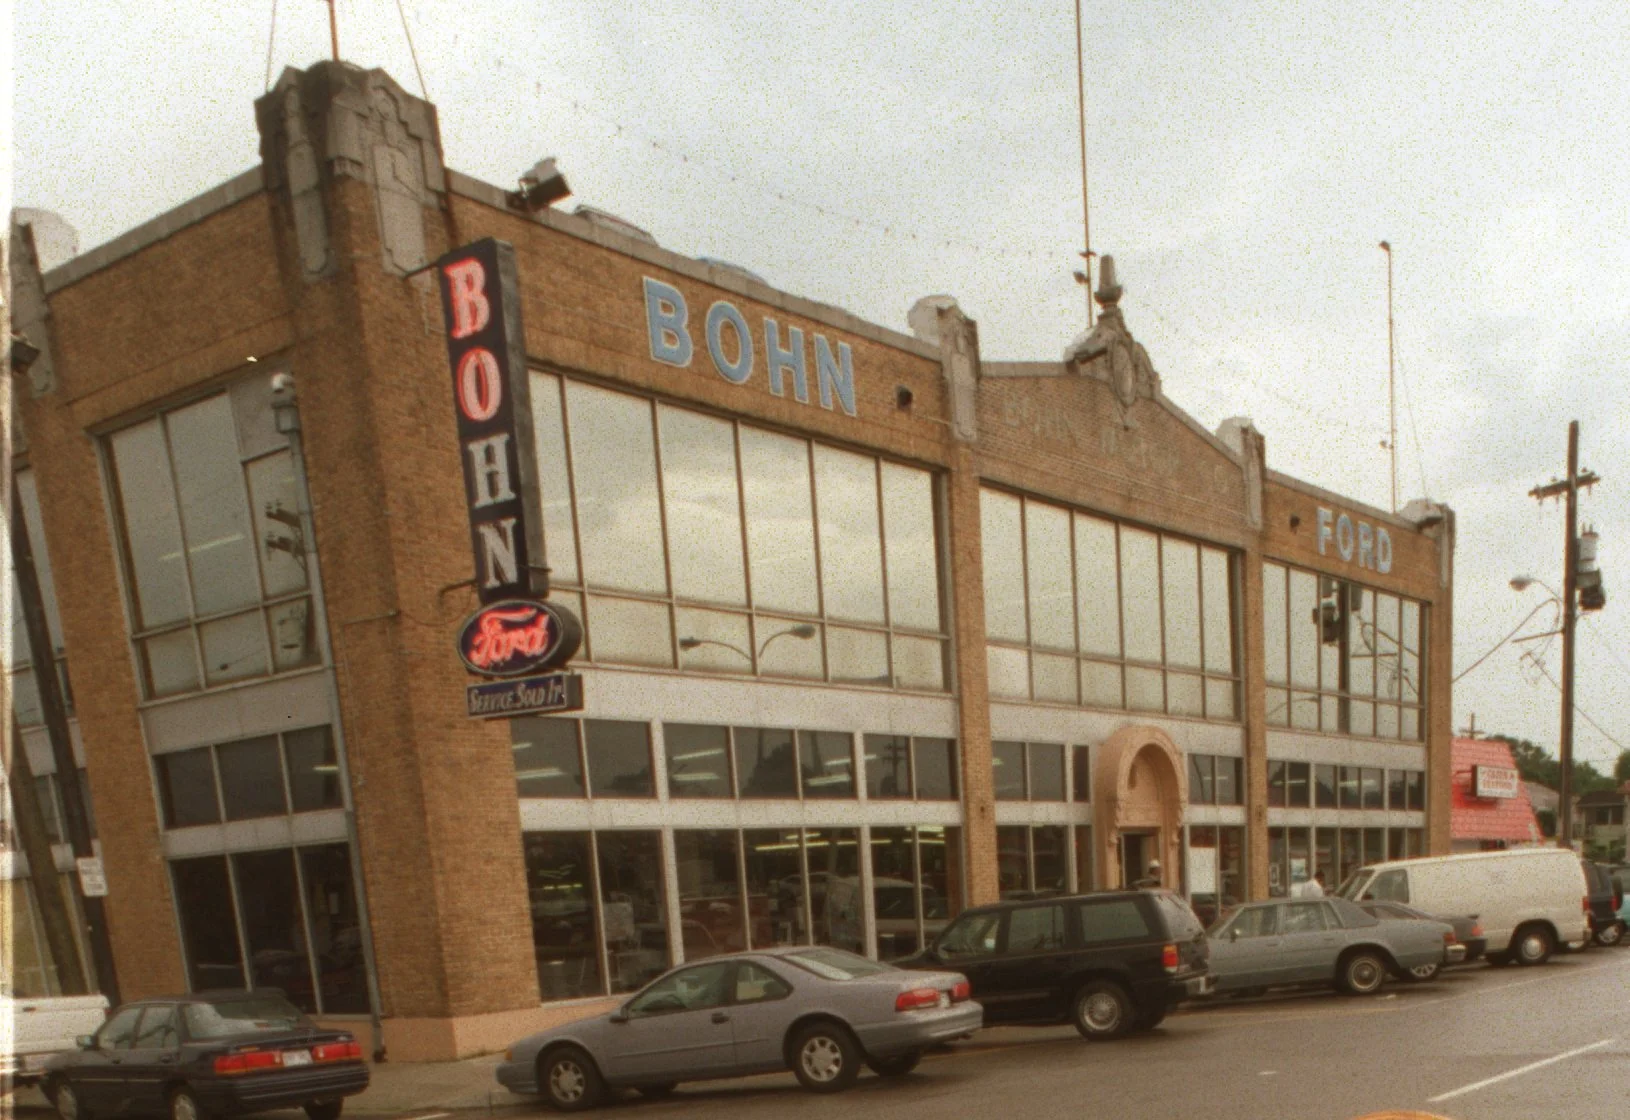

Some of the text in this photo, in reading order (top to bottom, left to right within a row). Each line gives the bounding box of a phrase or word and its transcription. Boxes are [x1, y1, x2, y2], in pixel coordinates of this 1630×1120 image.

[642, 275, 857, 417] BOHN
[445, 257, 519, 589] BOHN
[1317, 506, 1392, 574] FORD
[470, 606, 549, 668] Ford
